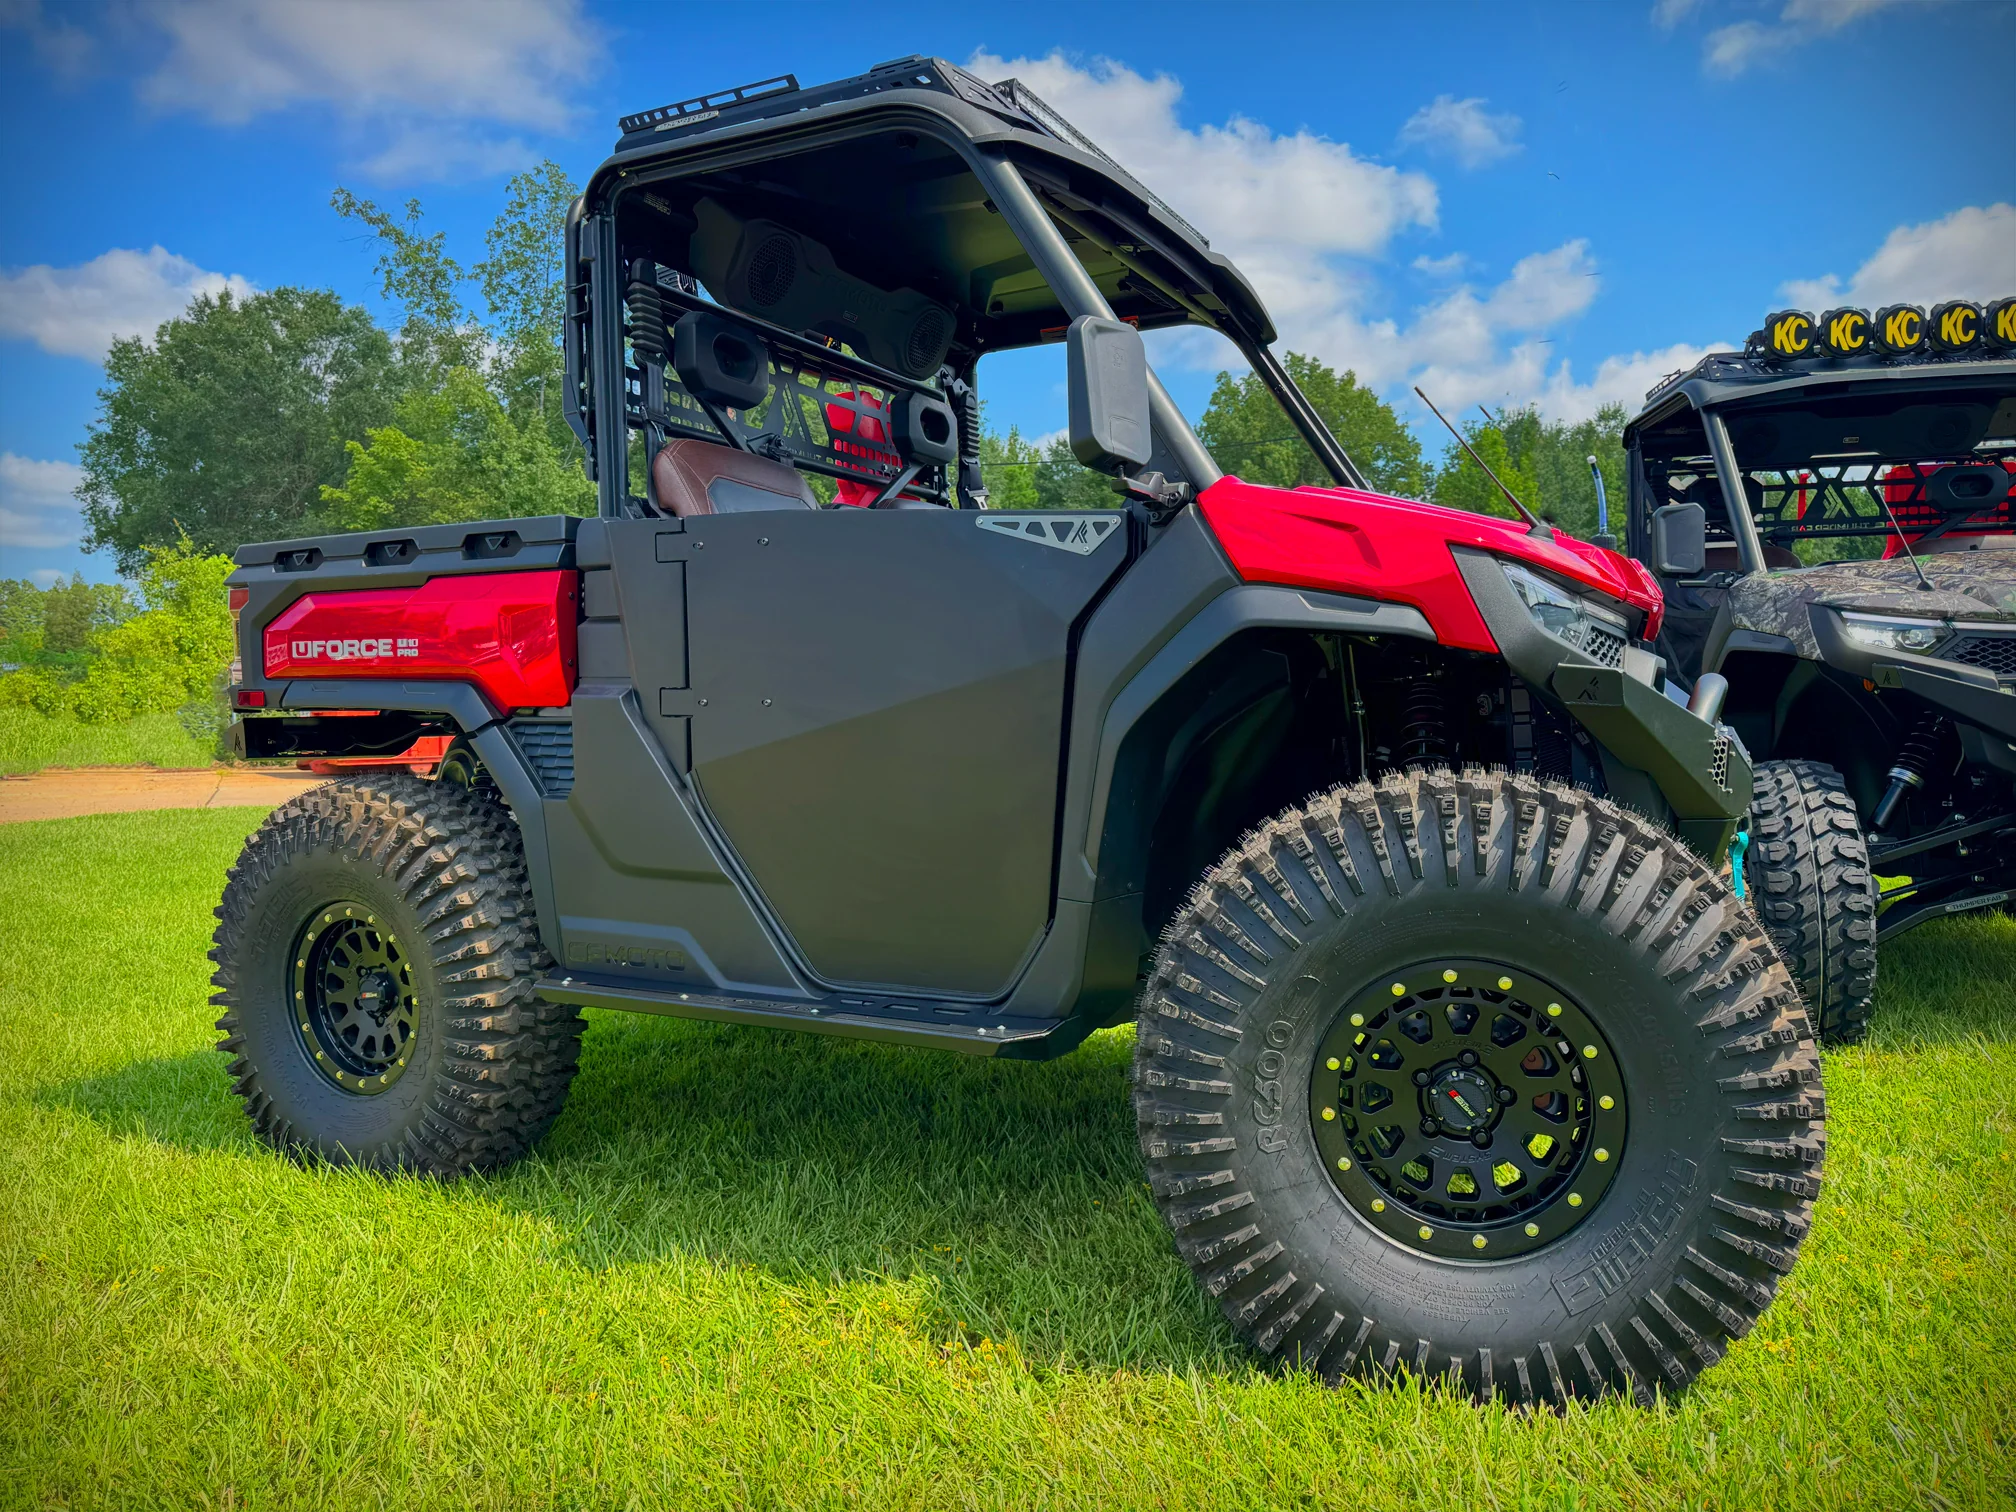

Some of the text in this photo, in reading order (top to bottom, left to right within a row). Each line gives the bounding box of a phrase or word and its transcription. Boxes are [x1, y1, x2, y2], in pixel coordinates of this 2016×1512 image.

[1774, 316, 1808, 353] KC
[1830, 313, 1864, 351] KC
[1886, 310, 1920, 348] KC
[1941, 307, 1976, 345] KC
[1997, 303, 2016, 342] K
[292, 639, 394, 659] UFORCE
[396, 648, 419, 657] PRO
[568, 942, 685, 971] CFMOTO
